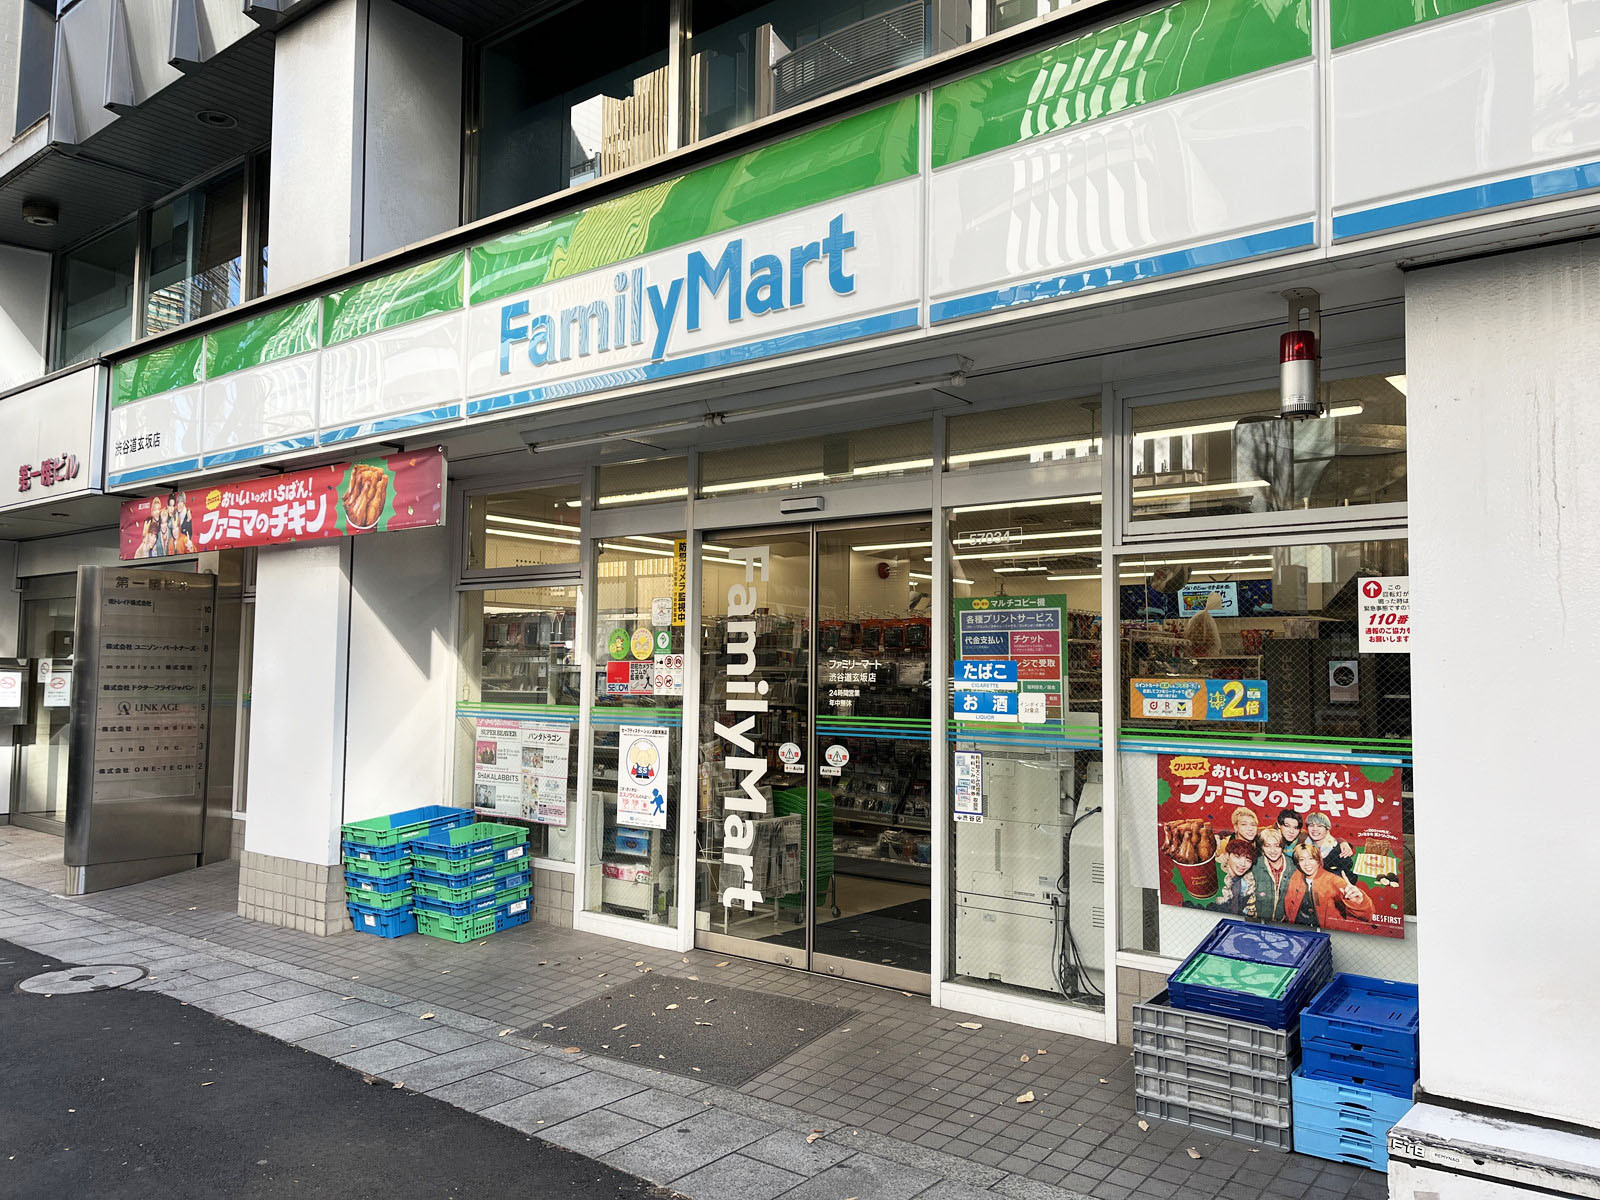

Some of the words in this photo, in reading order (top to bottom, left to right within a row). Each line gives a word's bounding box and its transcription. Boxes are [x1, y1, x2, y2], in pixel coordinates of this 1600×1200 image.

[500, 213, 856, 375] FamilyMart
[115, 432, 161, 456] 渋谷道玄坂店
[199, 494, 328, 544] ファミマのチキン
[969, 530, 1010, 546] 57034
[991, 598, 1045, 607] マルチコピー機
[204, 606, 212, 614] 10
[966, 613, 1054, 624] 各種プリントサービス
[1369, 613, 1409, 626] 110番
[964, 635, 1004, 645] 代金支払い
[1013, 634, 1045, 644] チケット
[1368, 635, 1409, 643] お願いします
[828, 659, 882, 670] ファミリーマート
[963, 663, 1007, 680] たばこ
[828, 672, 877, 683] 渋谷道玄坂店
[607, 683, 629, 692] SECOM
[828, 689, 860, 697] 24時間営業
[828, 699, 853, 707] 年中無休
[714, 545, 770, 911] FamilyMart
[1173, 762, 1207, 772] クリスマス
[477, 772, 519, 782] SHAKALABBITS
[1180, 778, 1374, 818] ファミマのチキン
